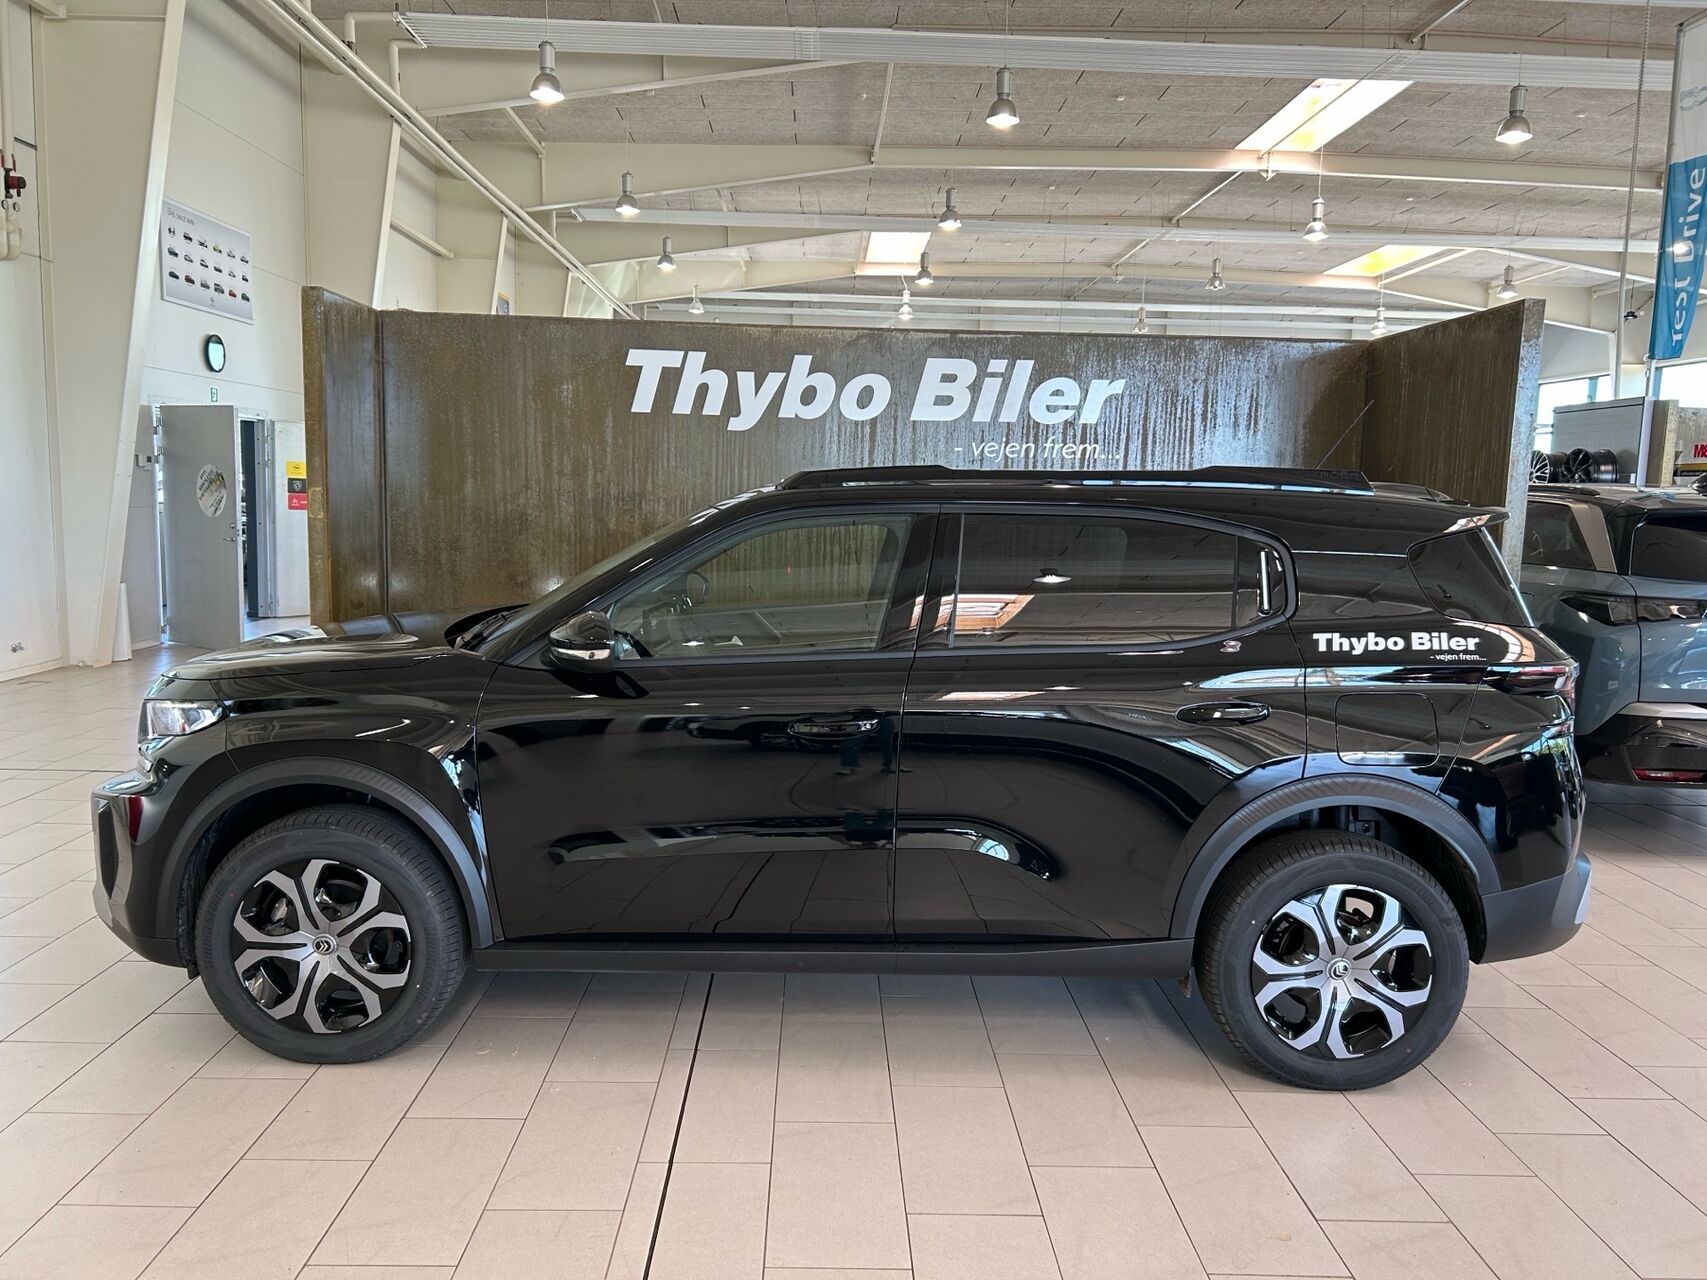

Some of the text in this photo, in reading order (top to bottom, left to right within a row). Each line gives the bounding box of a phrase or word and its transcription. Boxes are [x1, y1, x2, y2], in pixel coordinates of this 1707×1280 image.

[1673, 167, 1706, 263] Drive
[624, 348, 1127, 432] Thybo Biler
[971, 439, 1035, 461] vejen
[1042, 436, 1122, 461] frem...
[1313, 632, 1480, 655] Thybo Biler
[1435, 653, 1458, 662] vejen
